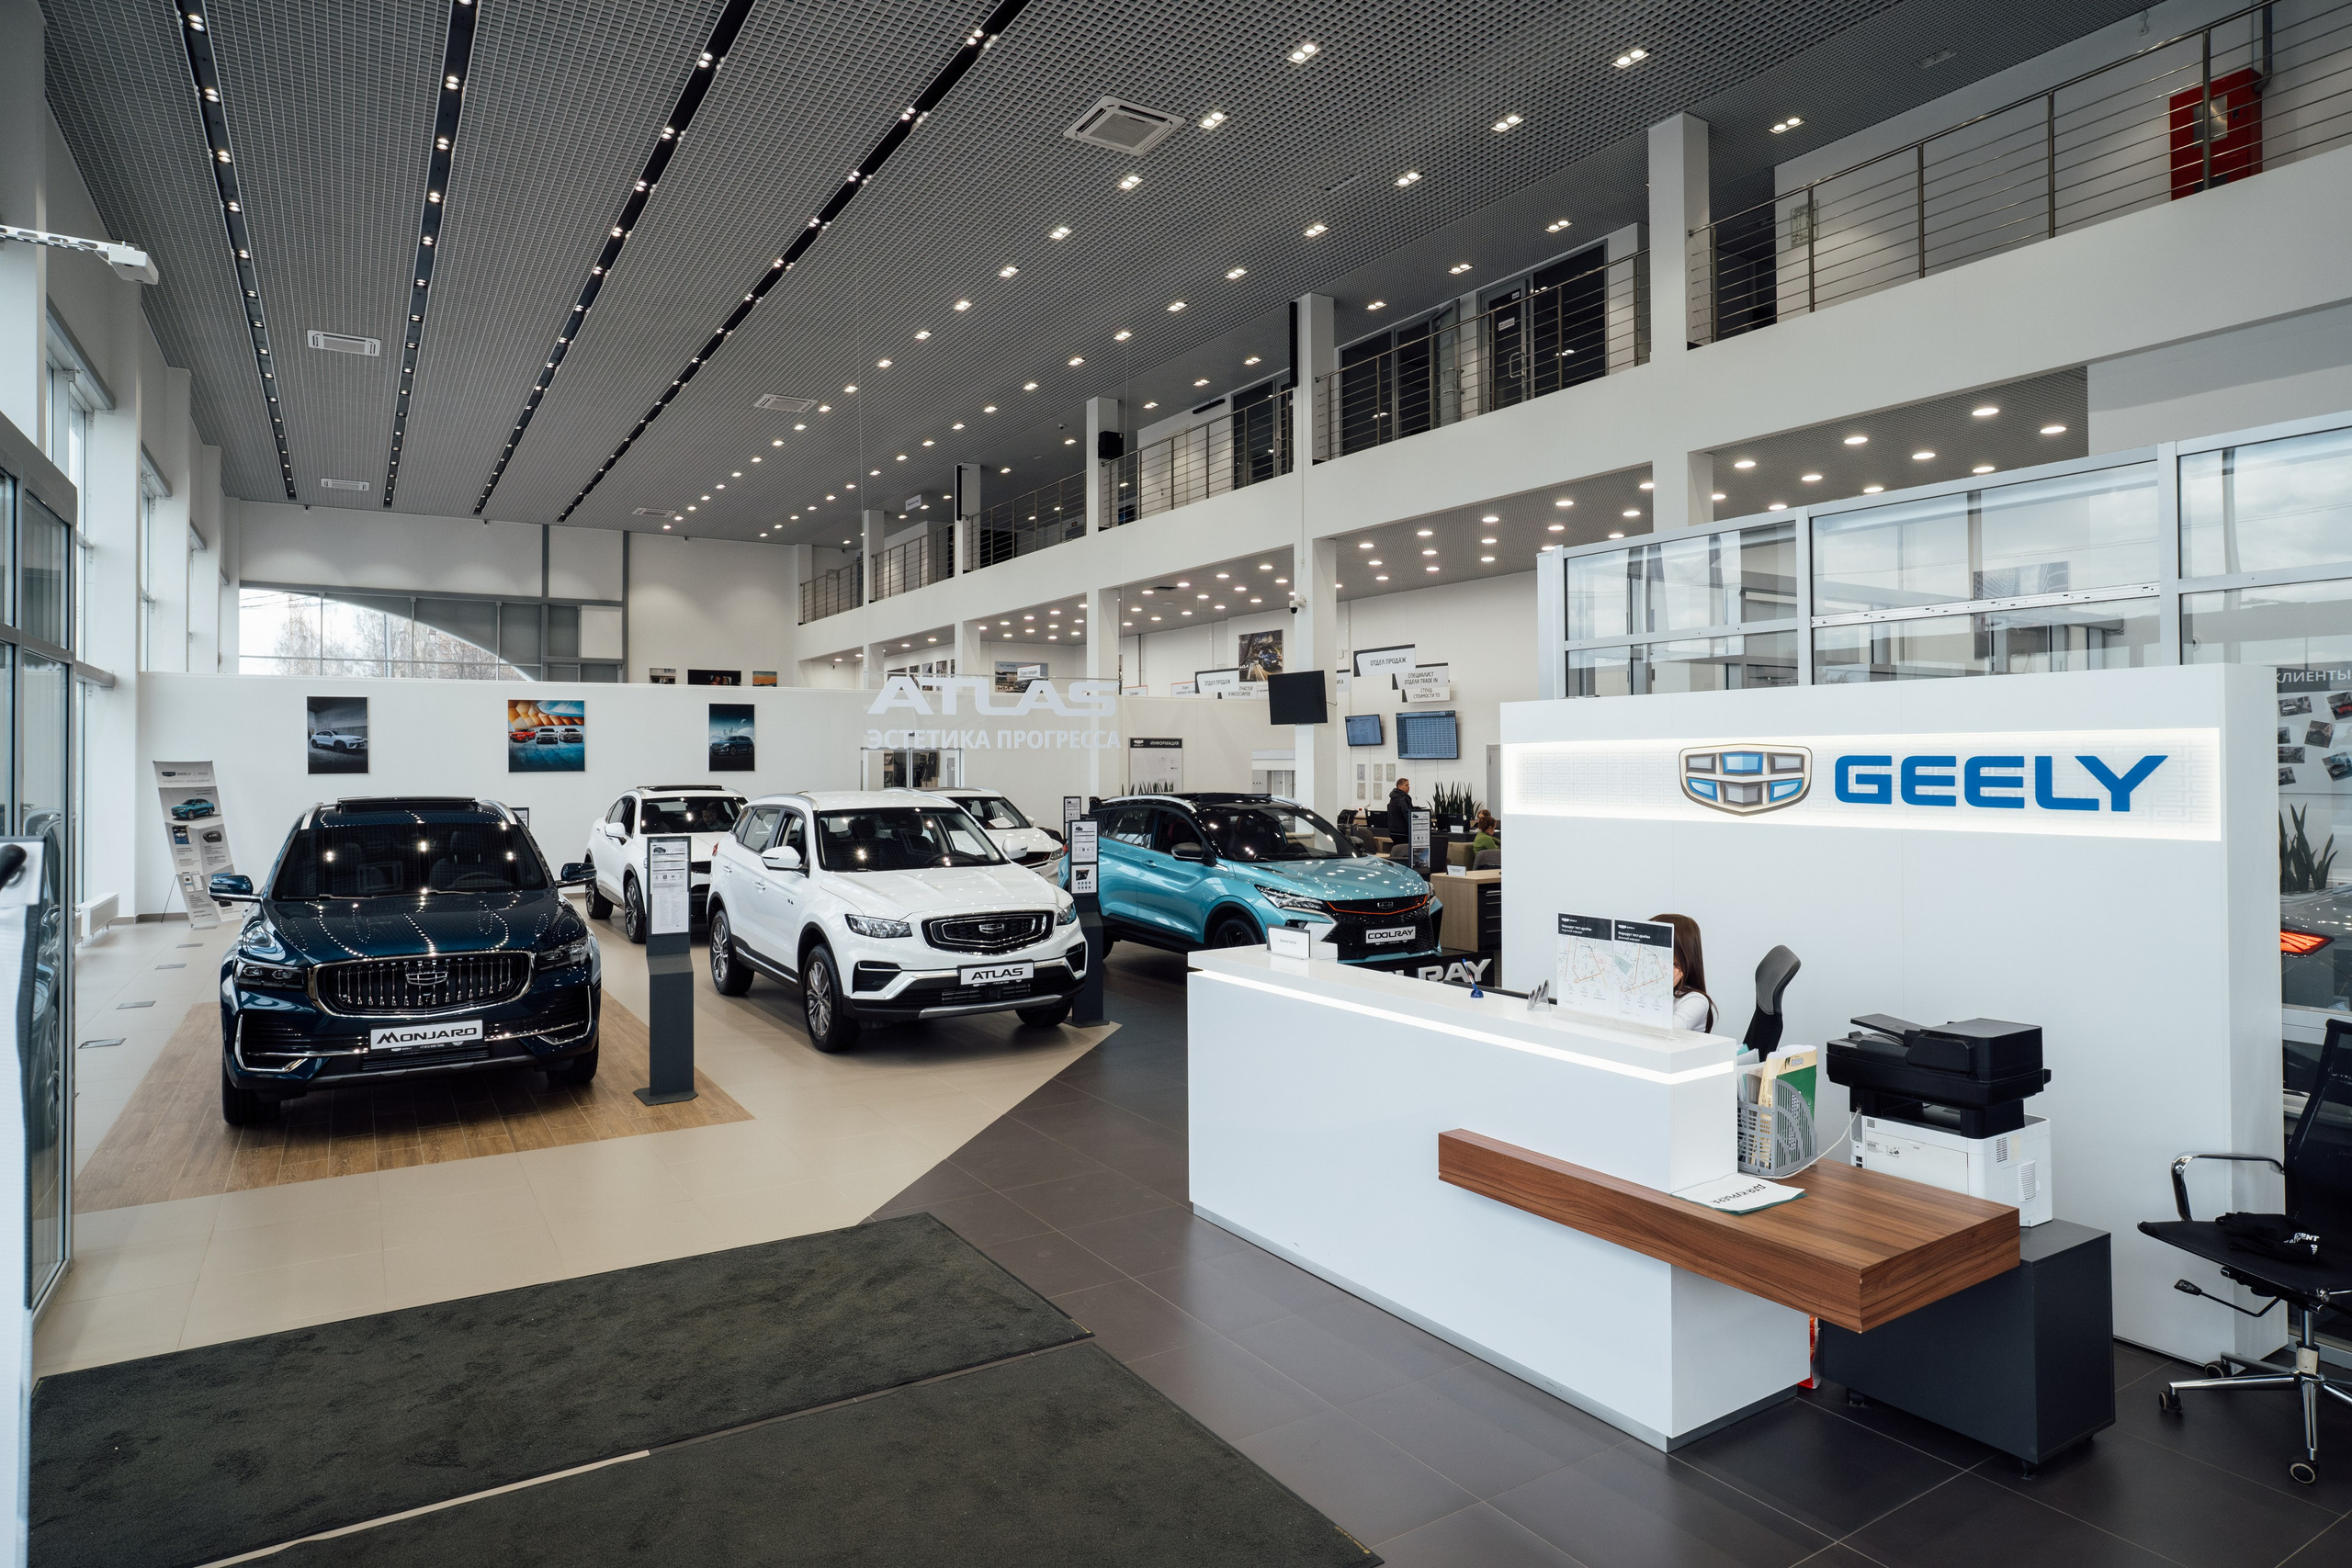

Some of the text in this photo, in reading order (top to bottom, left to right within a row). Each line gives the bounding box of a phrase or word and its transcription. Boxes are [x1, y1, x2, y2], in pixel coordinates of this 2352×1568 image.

[867, 676, 1120, 716] ATLAS
[867, 728, 1122, 750] ЭСТЕТИКА ПРОГРЕССА
[1835, 755, 2169, 812] GEELY
[1368, 929, 1414, 940] COOLRAY
[971, 967, 1024, 980] ATLAS
[377, 1027, 478, 1044] MONJARO
